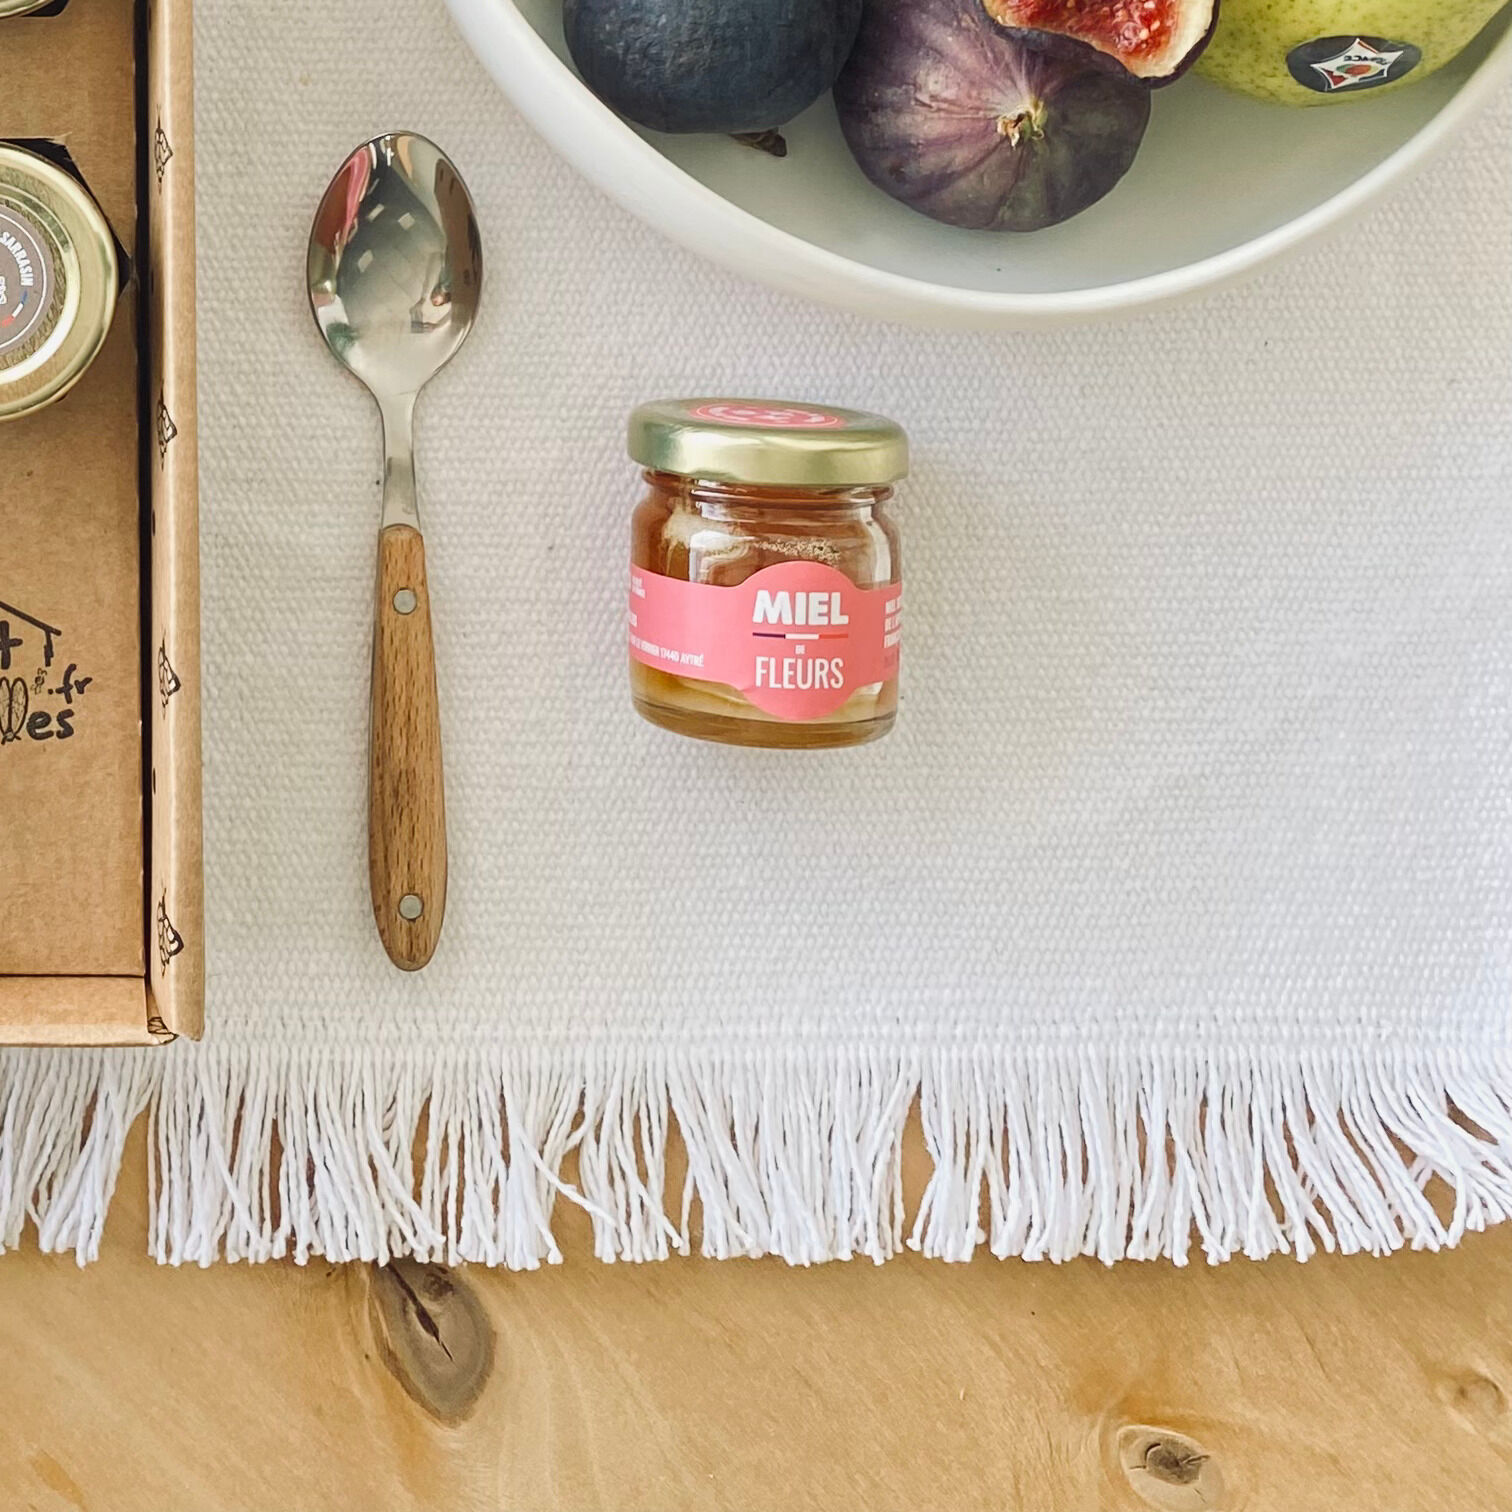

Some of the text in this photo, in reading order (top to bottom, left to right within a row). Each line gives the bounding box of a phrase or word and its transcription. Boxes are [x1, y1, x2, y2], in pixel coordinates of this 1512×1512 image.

[0, 232, 33, 286] SARRASIN
[752, 590, 849, 625] MIEL
[47, 663, 93, 704] .fr
[755, 656, 844, 690] FLEURS
